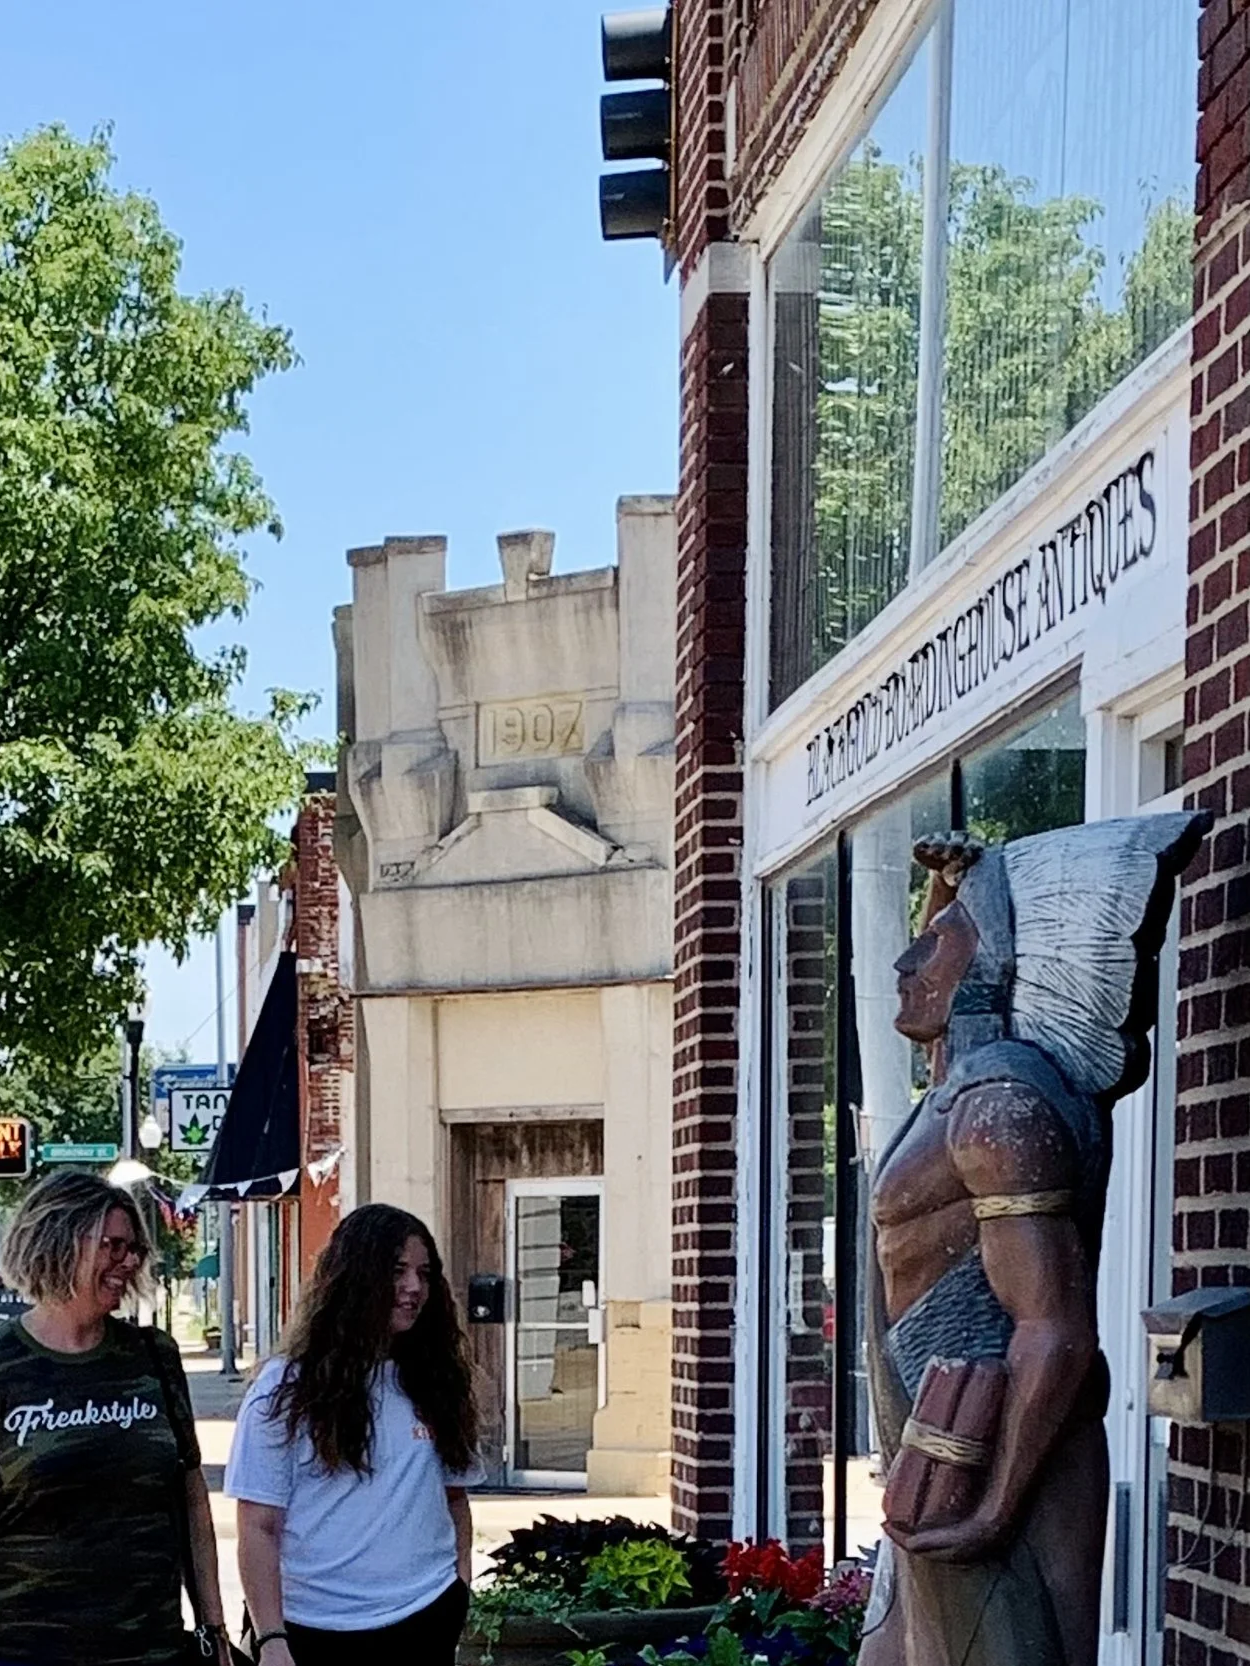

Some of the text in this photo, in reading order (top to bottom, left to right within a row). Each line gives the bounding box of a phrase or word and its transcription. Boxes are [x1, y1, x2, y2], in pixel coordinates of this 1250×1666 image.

[1035, 450, 1157, 640] ANTIQUES
[483, 700, 583, 756] 1907
[4, 1396, 157, 1447] Freakstyle
